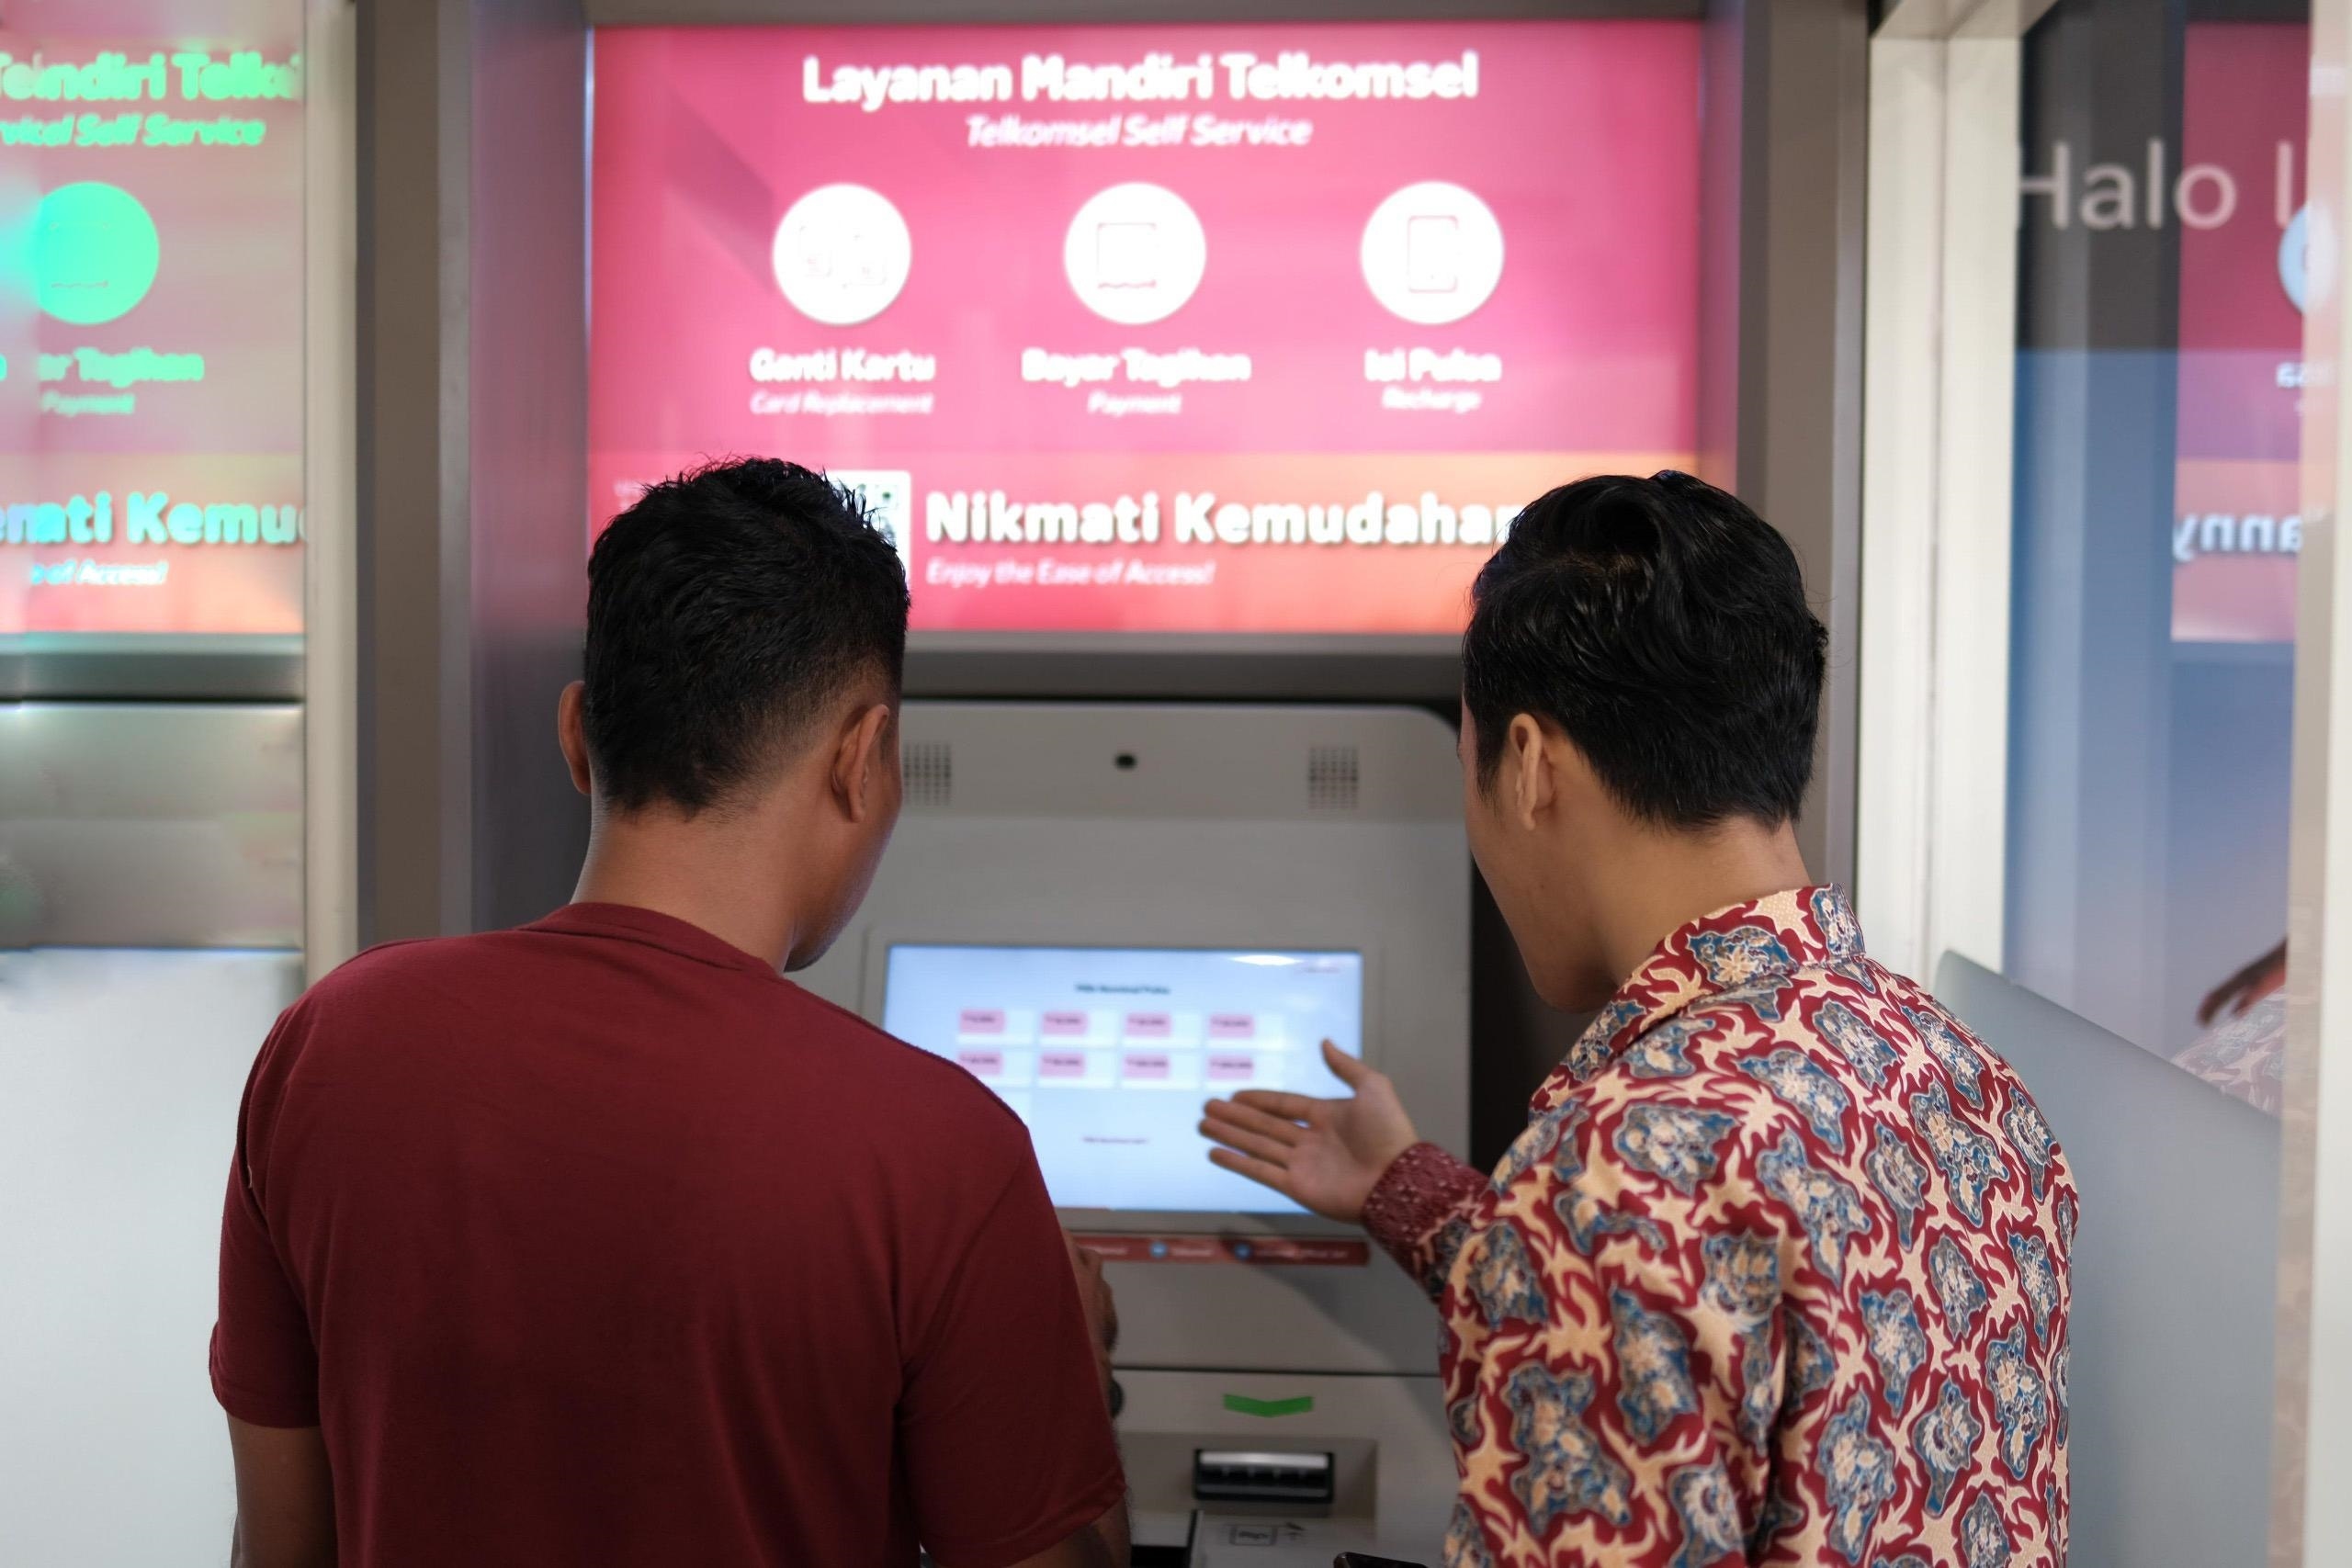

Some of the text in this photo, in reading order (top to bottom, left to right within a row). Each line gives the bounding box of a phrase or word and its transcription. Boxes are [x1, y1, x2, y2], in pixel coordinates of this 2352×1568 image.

[802, 49, 1479, 112] Layanan Mandiri Telkomsel
[966, 112, 1314, 147] Telkomsel Self Service
[2019, 137, 2238, 230] Halo
[749, 346, 936, 383] Ganti Kartu
[1021, 346, 1120, 389] Bayar
[127, 491, 306, 545] Kemu
[925, 490, 1160, 544] Nikmati
[926, 556, 992, 589] Enjoy
[994, 557, 1034, 585] the
[1035, 557, 1091, 585] Ease
[1093, 557, 1125, 585] of
